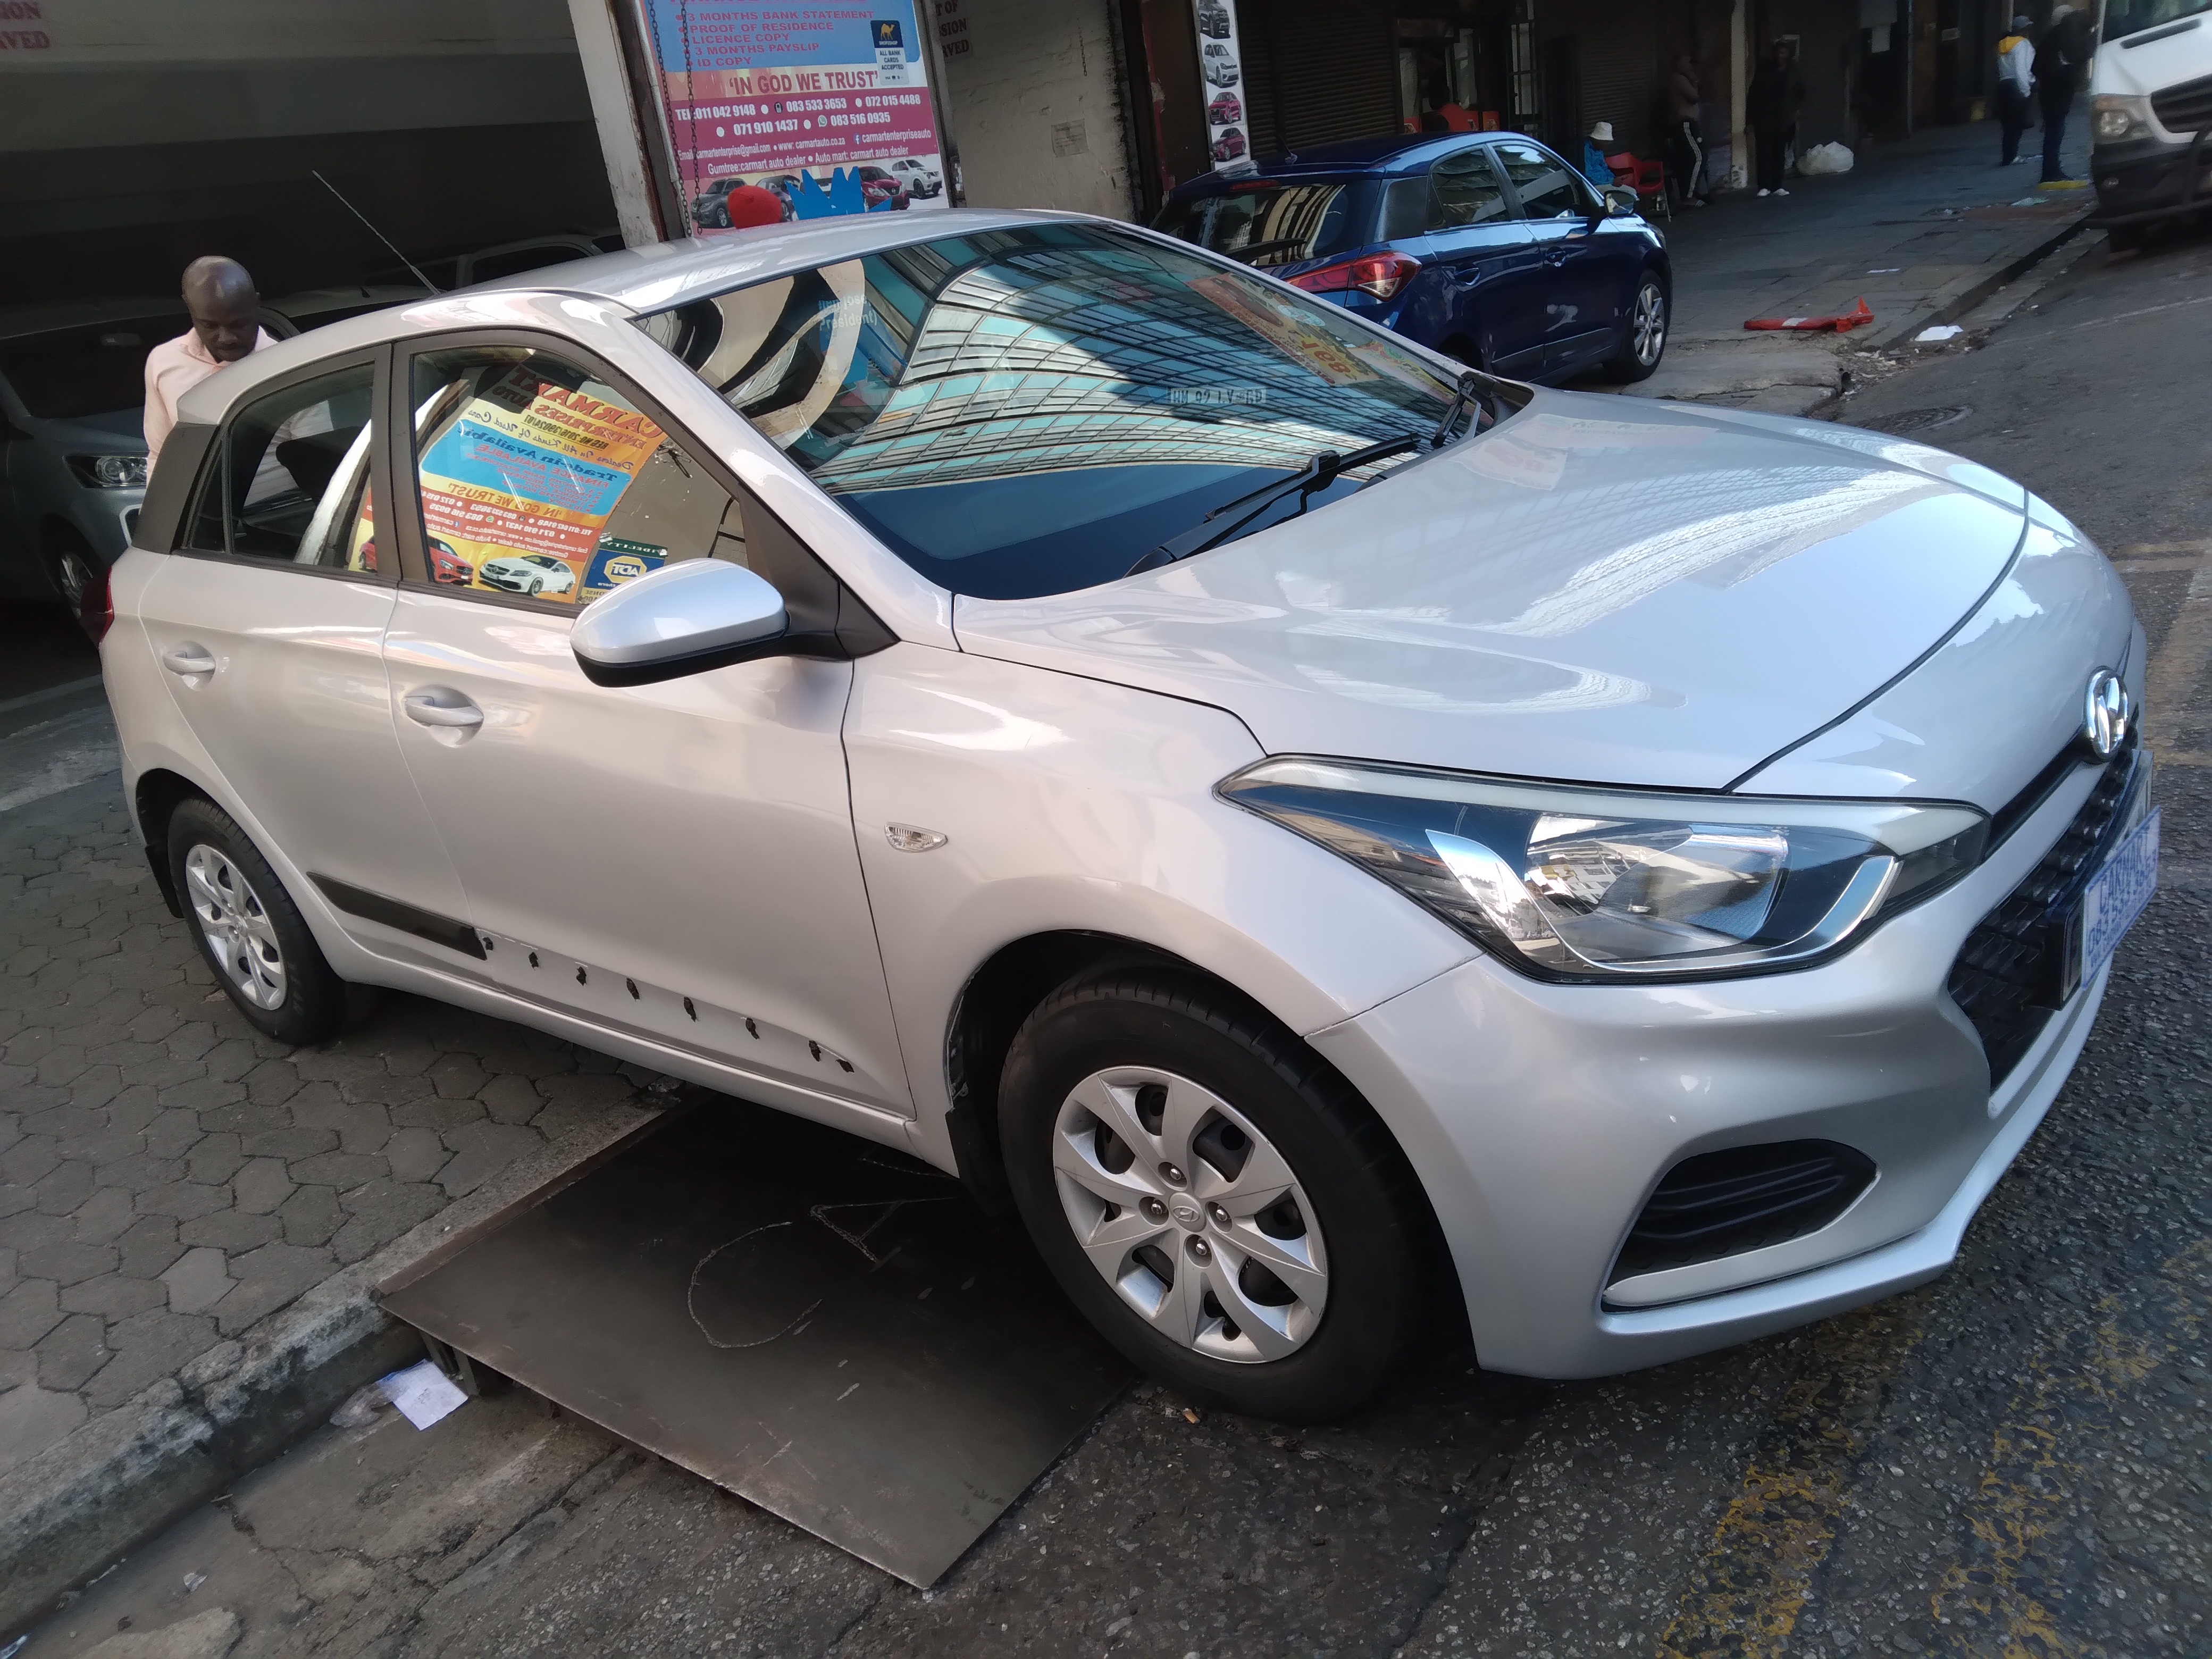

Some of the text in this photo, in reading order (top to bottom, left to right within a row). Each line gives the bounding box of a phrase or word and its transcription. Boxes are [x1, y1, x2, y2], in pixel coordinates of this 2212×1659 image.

[700, 12, 758, 21] MONTHS
[763, 11, 799, 20] BANK
[803, 11, 874, 19] STATEMENT
[690, 24, 735, 33] PROOF
[761, 22, 834, 31] RESIDENCE
[692, 33, 790, 45] LICENCE COPY
[695, 43, 819, 55] 3 MONTHS PAYSLIP
[697, 56, 751, 67] ID COPY
[758, 74, 792, 93] GOD
[795, 73, 822, 91] WE
[786, 98, 847, 112] 083 533 3653
[865, 94, 921, 107] 072 015 4488
[713, 106, 731, 118] 042
[733, 104, 756, 116] 9148
[830, 112, 891, 127] 083 516 0935
[733, 119, 798, 136] 071 910 1437
[862, 128, 932, 143] carmartenterpriseauto
[795, 137, 845, 149] carmartauto.co.za
[696, 144, 770, 159] carmartenterprise@gmail.com
[815, 153, 831, 163] Auto
[850, 149, 874, 160] carmart
[875, 148, 889, 157] auto
[890, 145, 909, 156] dealer
[769, 158, 784, 168] auto
[785, 154, 806, 166] dealer
